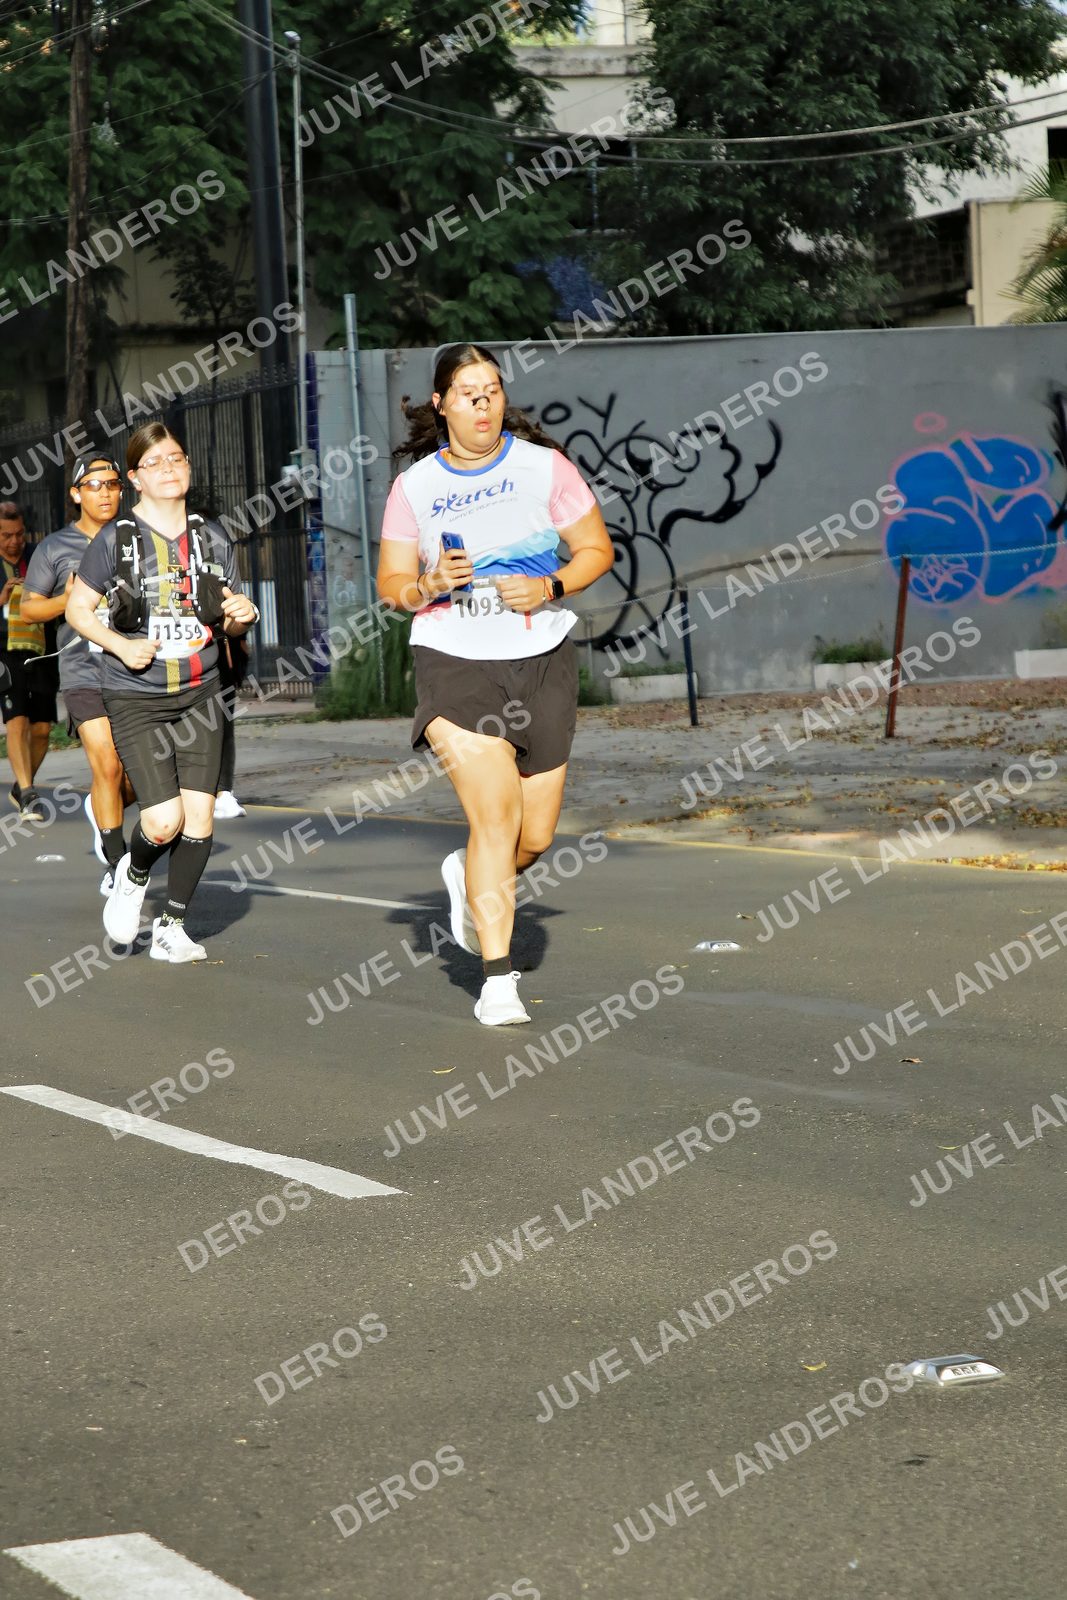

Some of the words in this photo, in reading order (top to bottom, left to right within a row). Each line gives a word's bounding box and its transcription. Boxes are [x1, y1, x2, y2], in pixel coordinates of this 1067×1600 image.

[520, 393, 616, 437] OY
[455, 595, 516, 618] 1093
[153, 623, 203, 640] 11559
